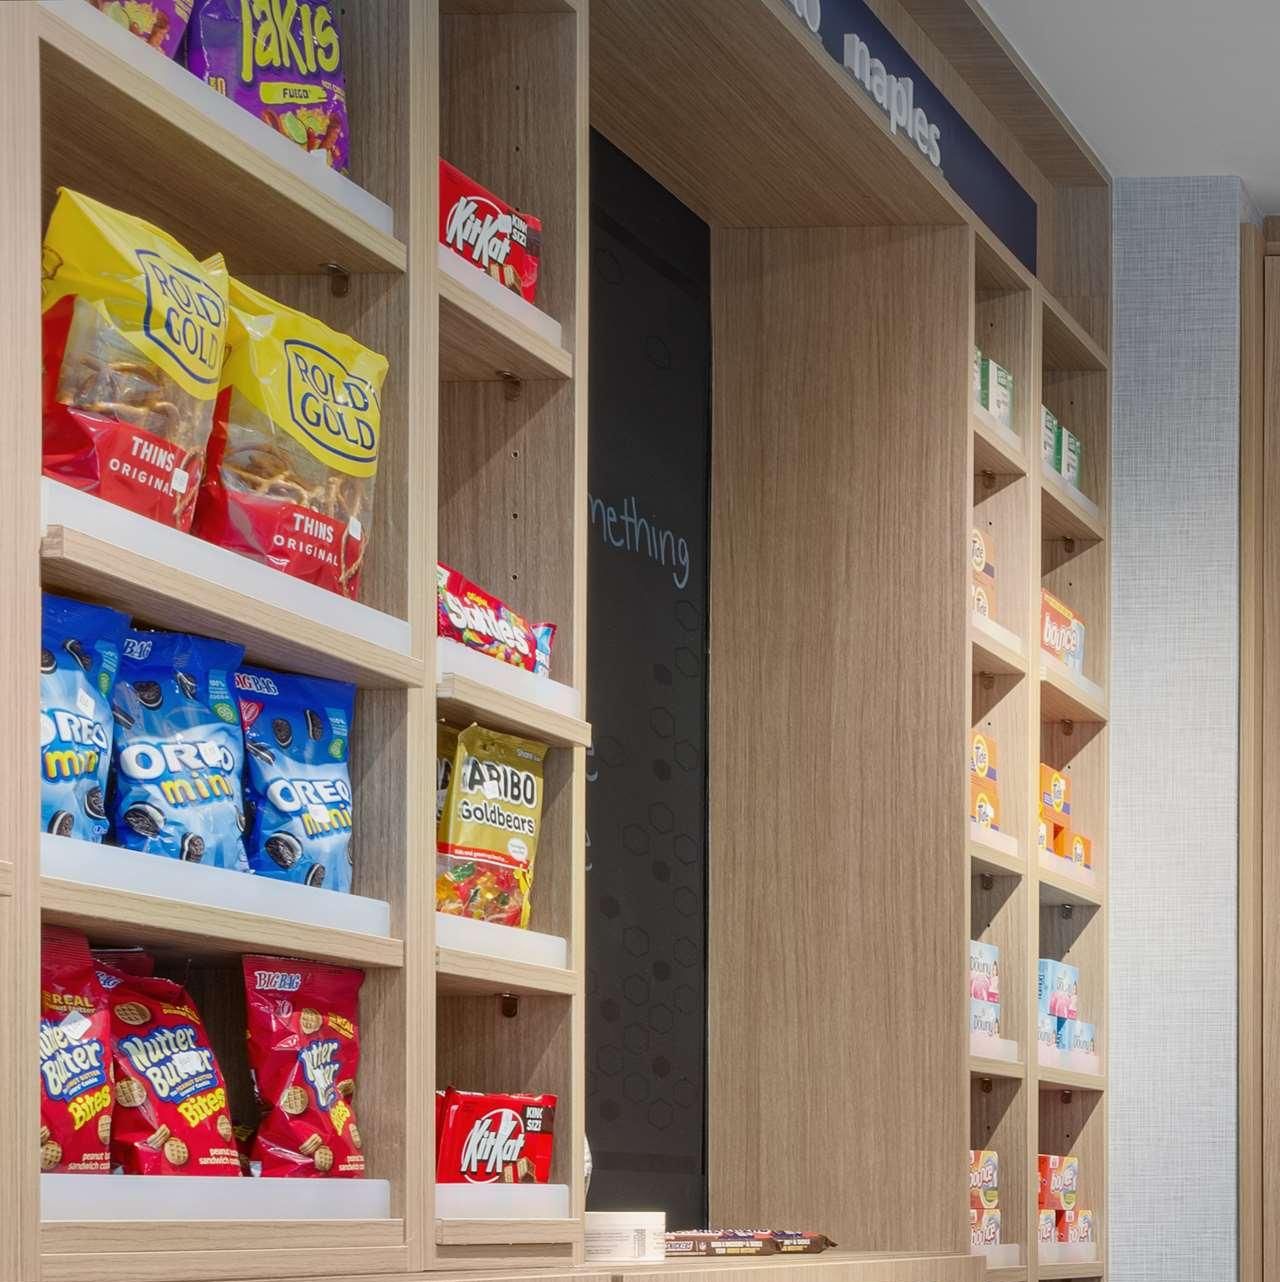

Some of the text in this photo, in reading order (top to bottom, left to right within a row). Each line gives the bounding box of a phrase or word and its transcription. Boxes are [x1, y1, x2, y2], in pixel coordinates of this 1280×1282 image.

[149, 264, 222, 328] ROLD
[164, 307, 219, 371] GOLD
[294, 353, 370, 411] ROLD
[301, 391, 376, 451] GOLD
[130, 436, 176, 472] THINS
[109, 457, 176, 498] ORIGINAL
[292, 512, 335, 544] THINS
[272, 534, 340, 567] ORIGINAL
[447, 592, 531, 657] Skittles
[266, 778, 351, 813] OREO
[460, 800, 535, 838] Goldbears
[52, 993, 95, 1008] REAL
[255, 971, 302, 992] BIG BAG
[43, 1041, 102, 1096] Butter
[122, 1026, 194, 1073] Nutter
[67, 1085, 112, 1131] Bites
[176, 1086, 226, 1128] Bites
[461, 1110, 526, 1174] KitKat
